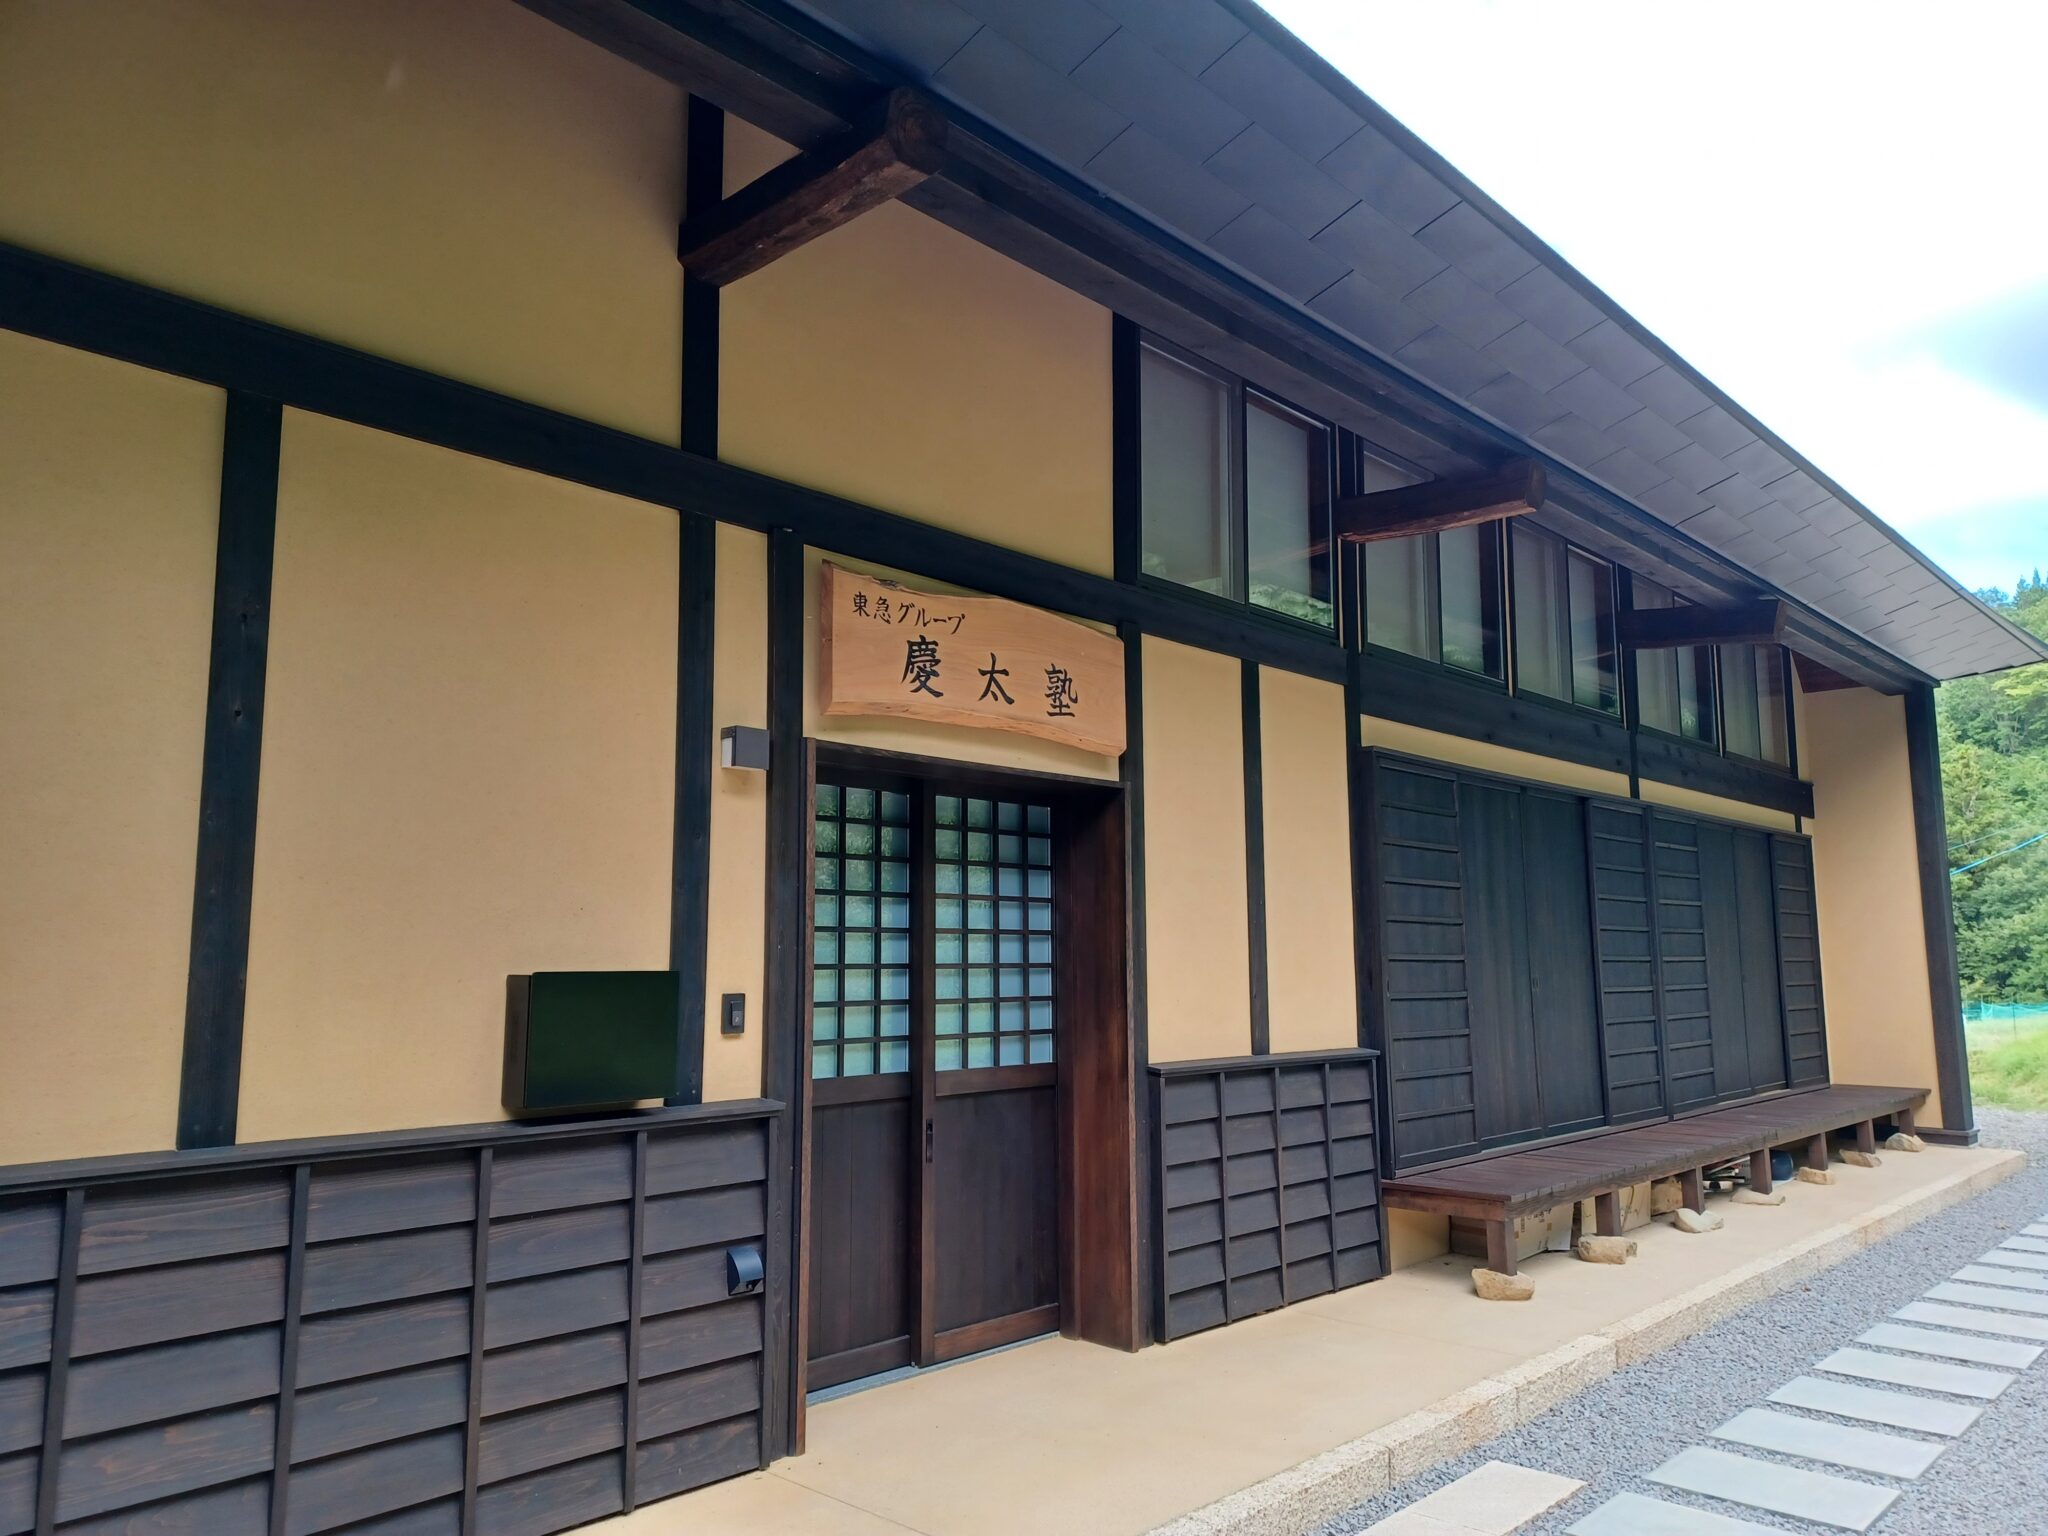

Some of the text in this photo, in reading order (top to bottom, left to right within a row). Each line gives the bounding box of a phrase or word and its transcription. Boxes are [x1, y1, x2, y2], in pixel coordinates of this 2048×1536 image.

[852, 591, 966, 635] 東急グループ
[901, 634, 1078, 718] 慶太塾
